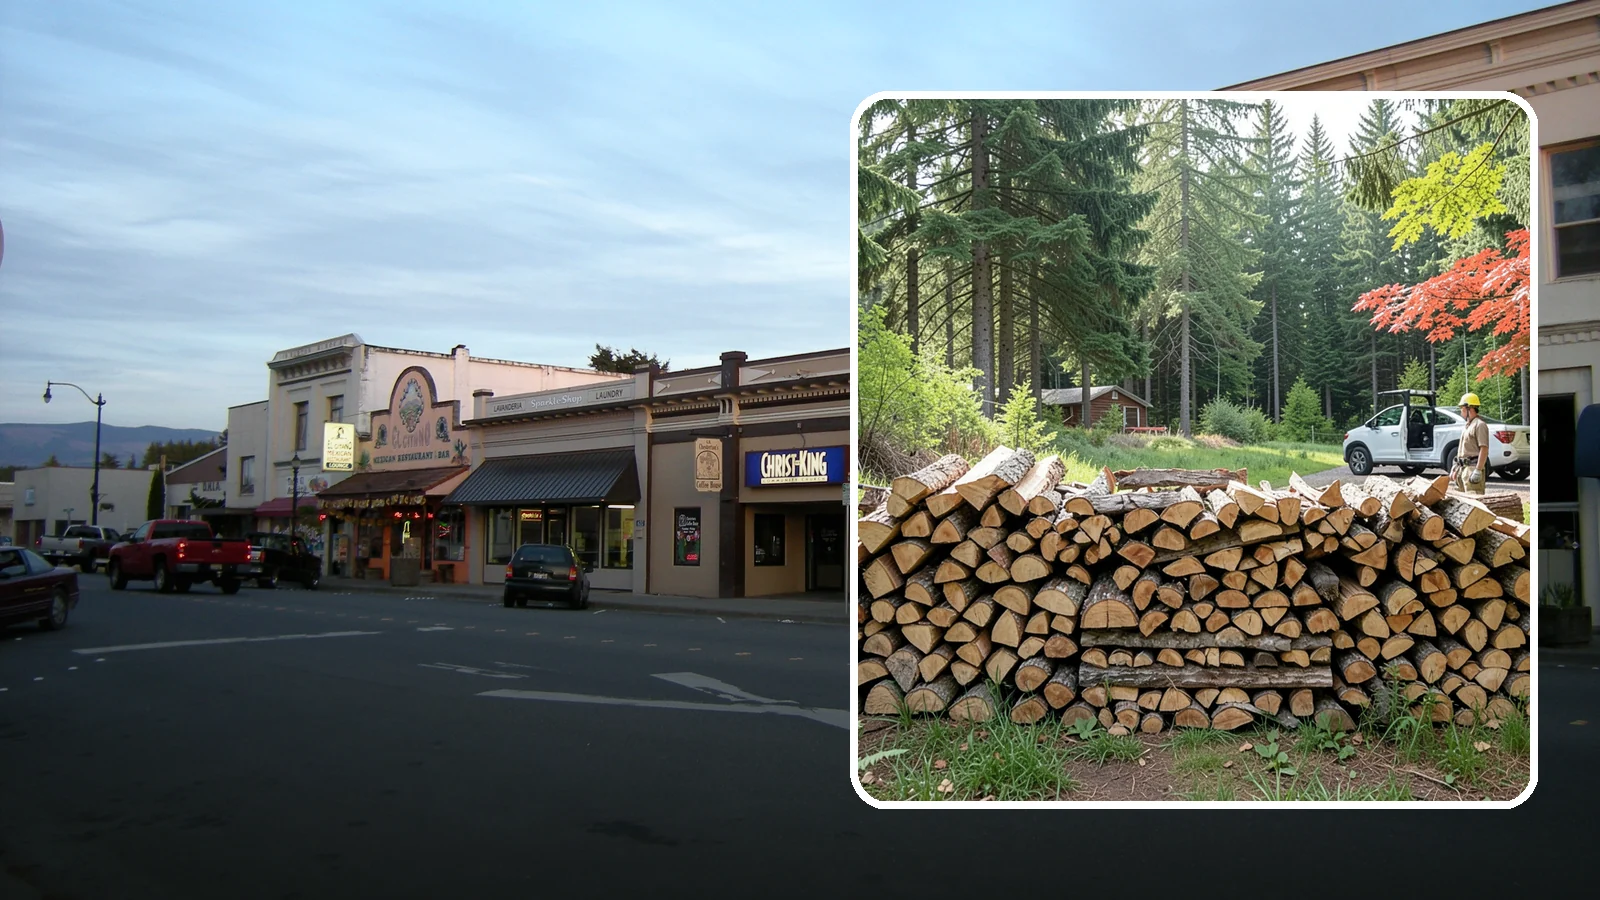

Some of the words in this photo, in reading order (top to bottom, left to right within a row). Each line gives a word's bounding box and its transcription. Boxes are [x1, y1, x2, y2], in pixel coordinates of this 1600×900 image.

[530, 397, 560, 409] Sparkle
[561, 394, 582, 407] Shop
[595, 389, 623, 400] LAUNDRY
[493, 402, 522, 412] LAVANDERIA
[373, 455, 395, 464] MEXICAN
[397, 451, 433, 462] RESTAURANT
[438, 450, 450, 459] BAR
[760, 452, 797, 478] CHRIST
[798, 449, 827, 477] KING
